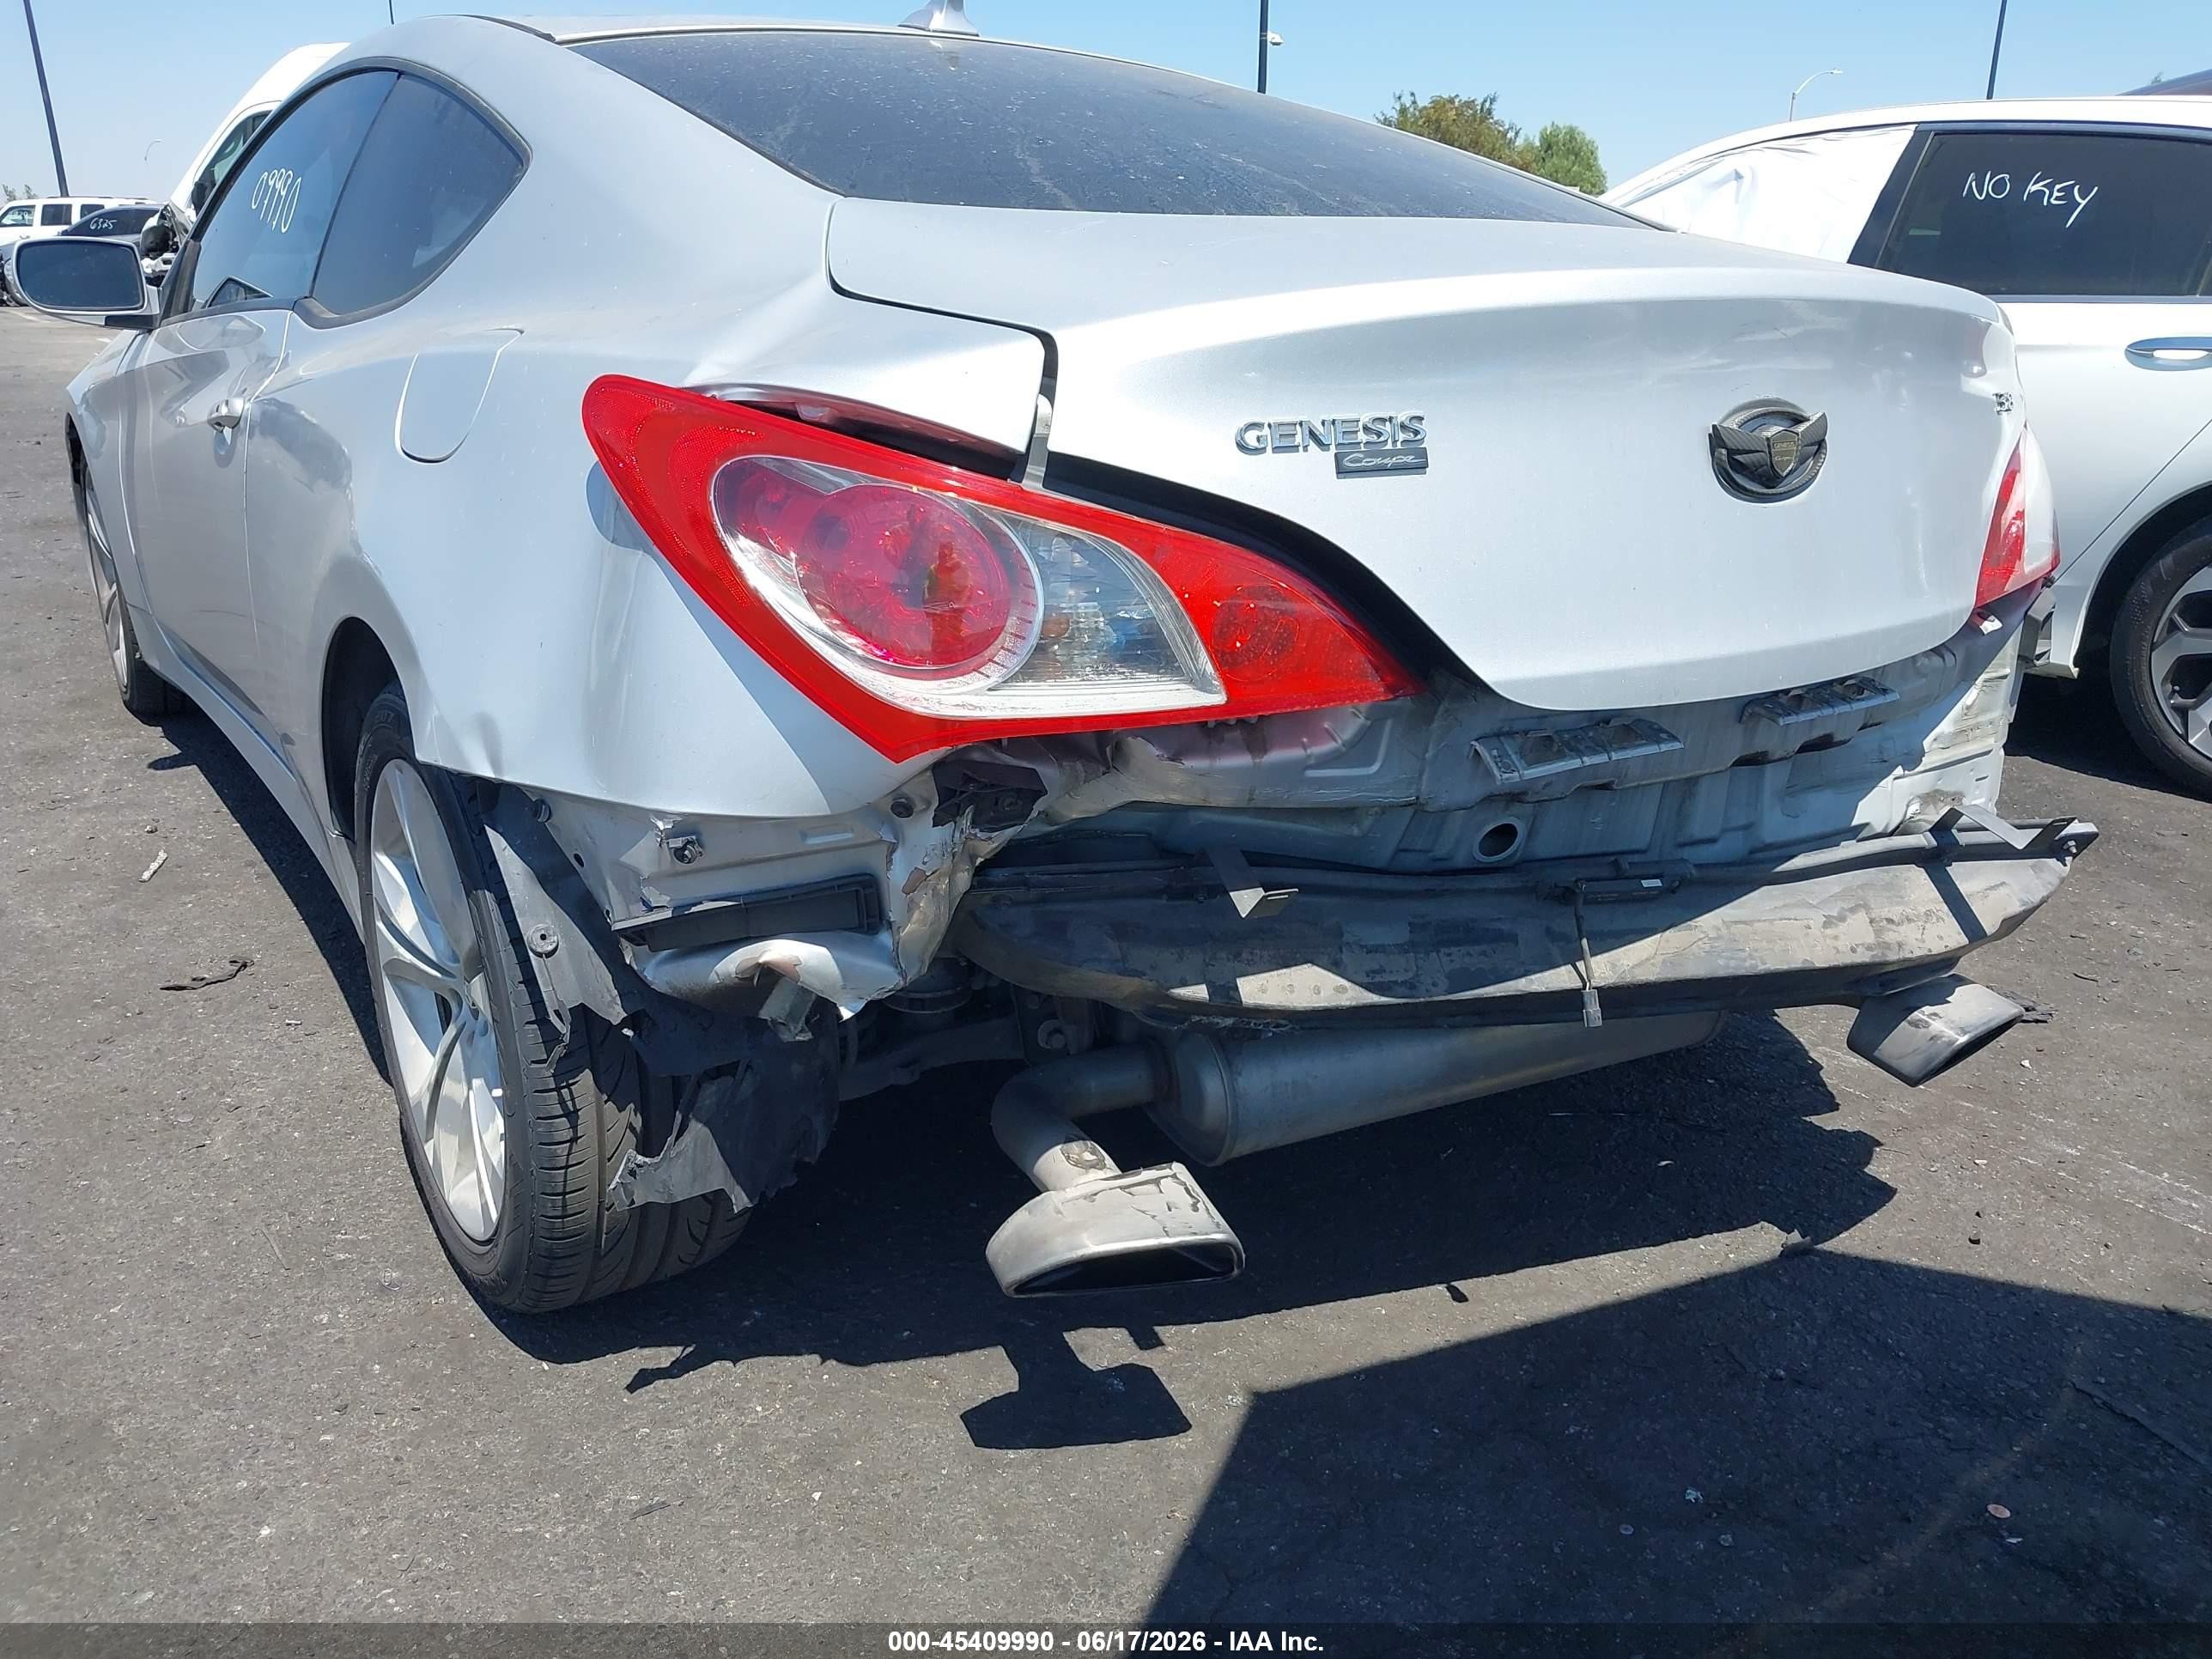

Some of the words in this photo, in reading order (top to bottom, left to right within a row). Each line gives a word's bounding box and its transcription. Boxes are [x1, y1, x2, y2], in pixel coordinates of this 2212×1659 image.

[251, 167, 302, 234] 09990
[1962, 170, 2011, 201] NO
[2023, 171, 2099, 228] KEY
[89, 216, 118, 230] 6325
[1235, 414, 1427, 455] GENESIS
[1343, 452, 1426, 468] Coupe
